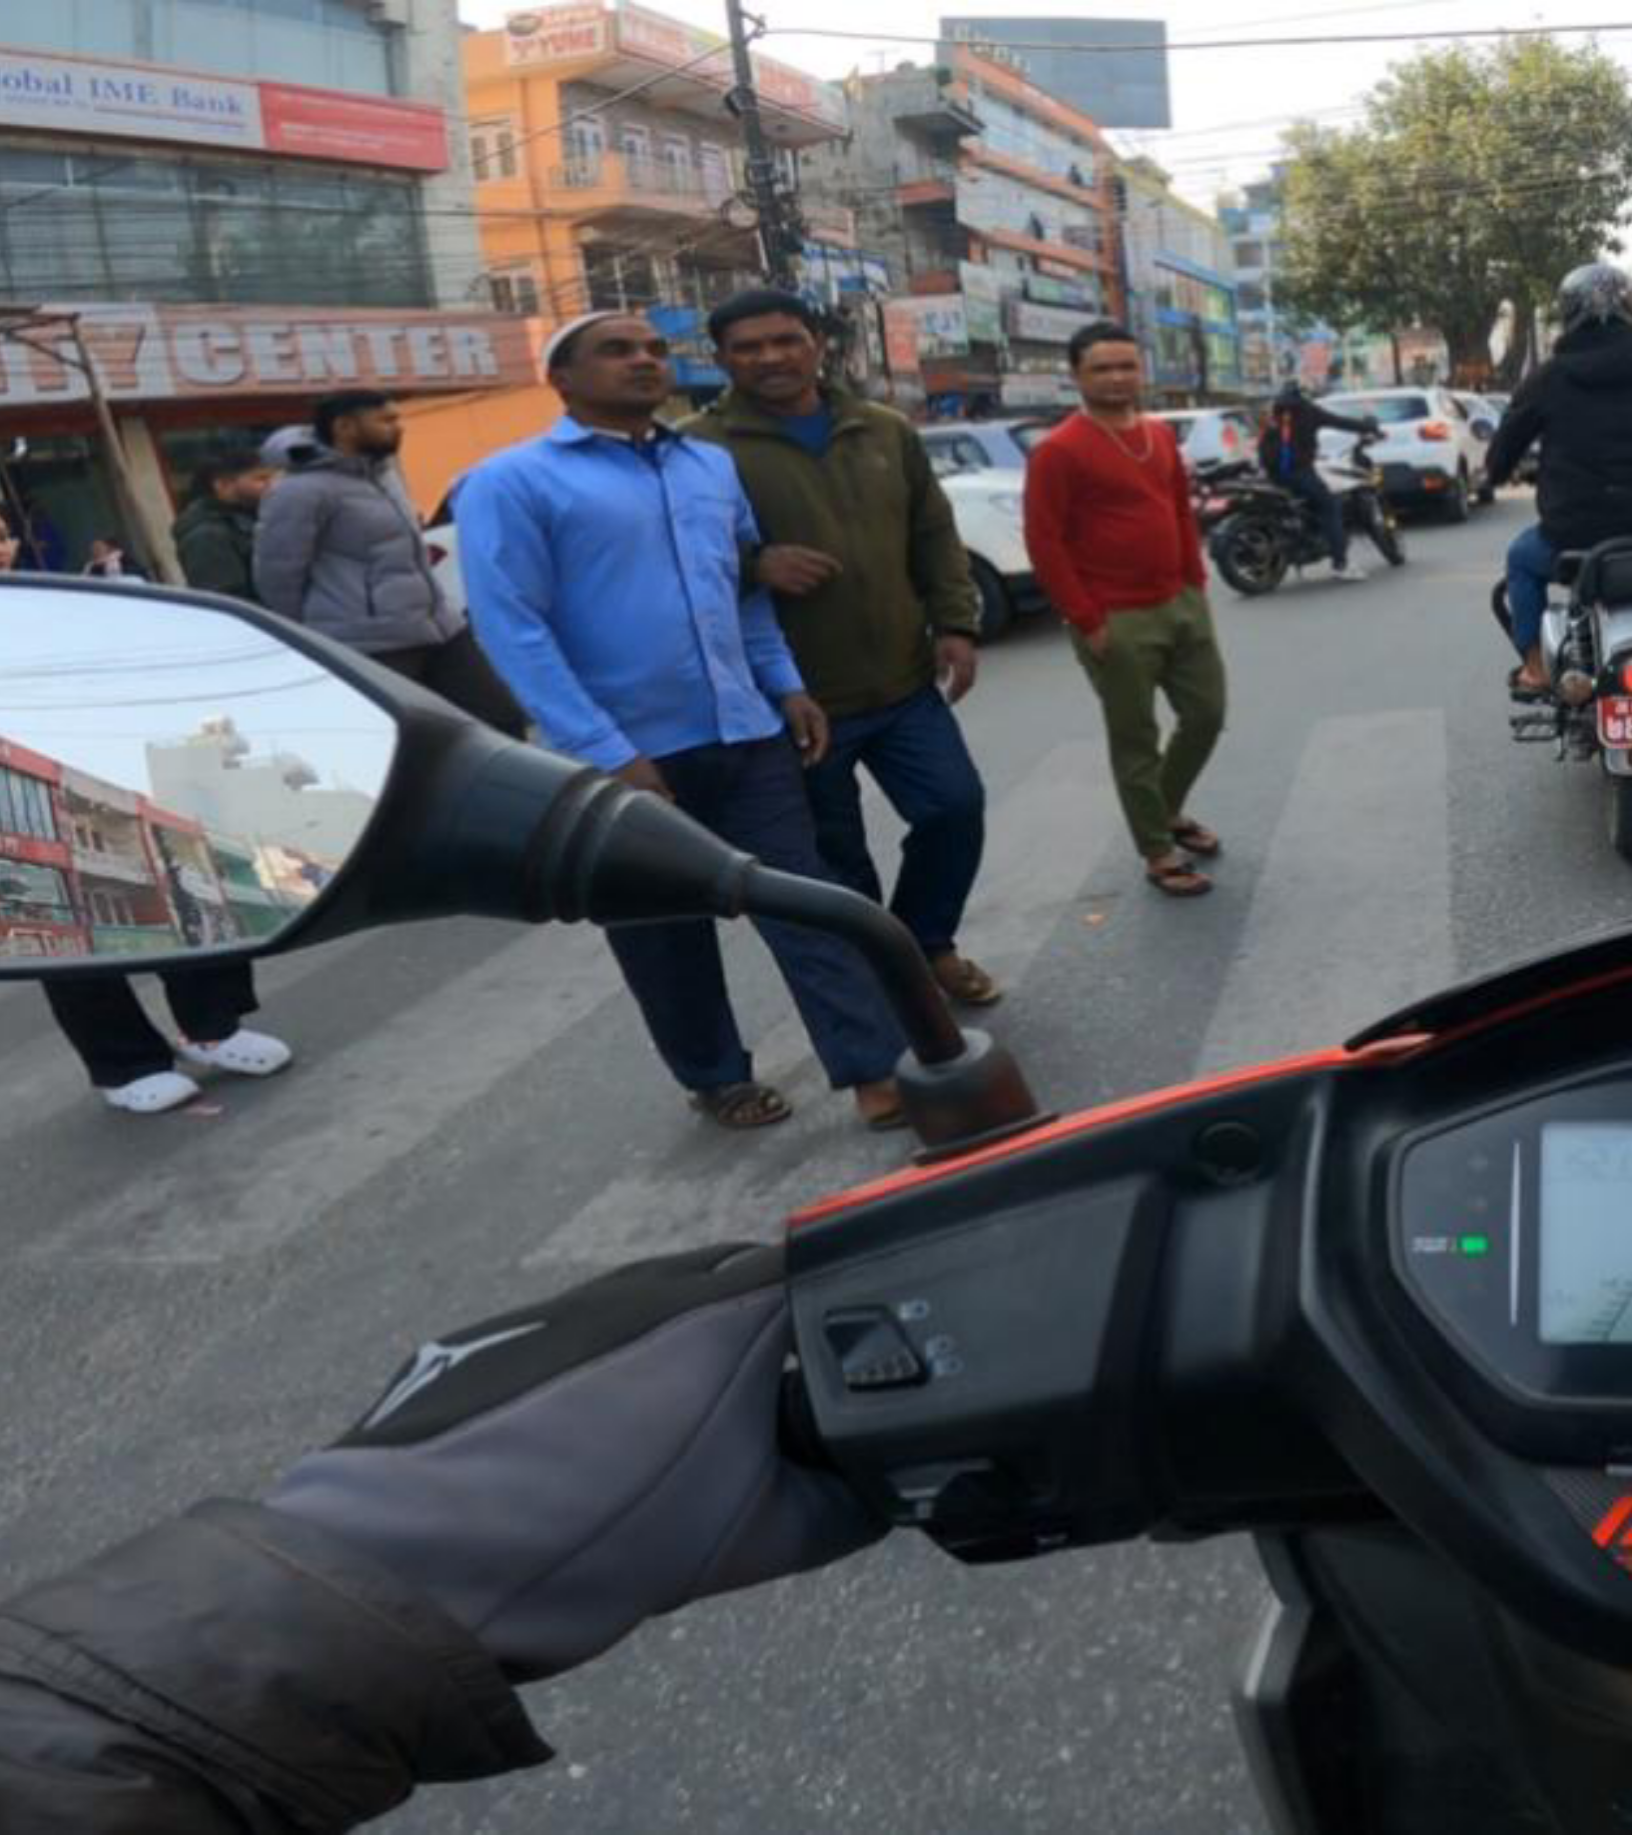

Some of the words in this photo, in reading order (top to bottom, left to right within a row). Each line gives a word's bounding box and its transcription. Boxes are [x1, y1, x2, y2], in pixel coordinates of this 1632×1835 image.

[91, 77, 158, 105] IME
[173, 86, 242, 116] Bank
[176, 321, 499, 386] CENTER
